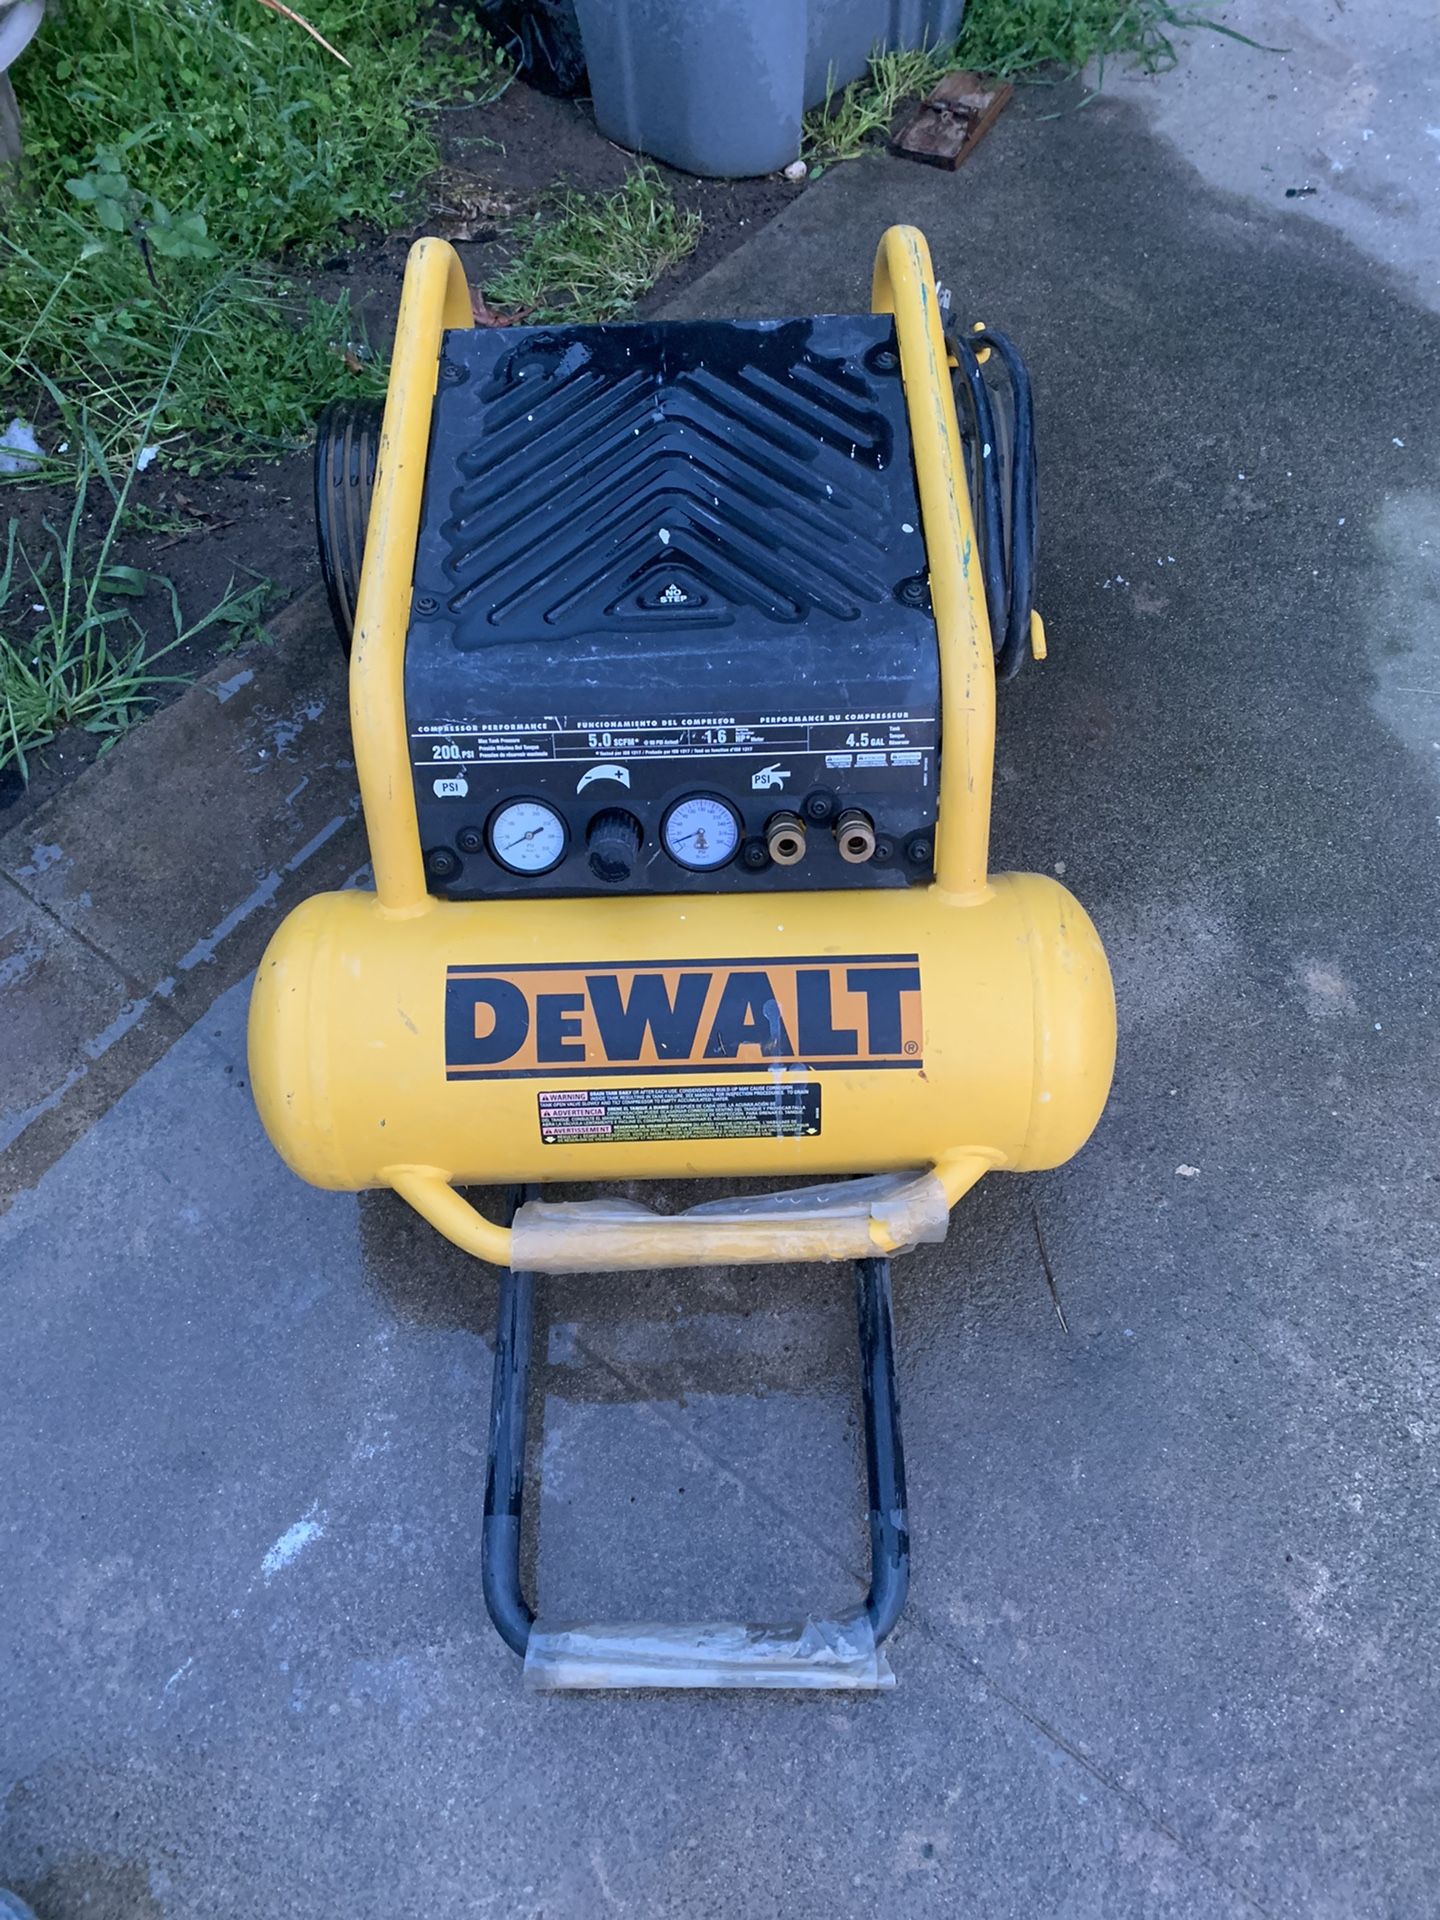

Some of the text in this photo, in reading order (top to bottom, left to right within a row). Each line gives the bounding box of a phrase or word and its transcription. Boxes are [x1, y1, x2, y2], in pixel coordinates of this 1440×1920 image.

[760, 715, 824, 723] PERFORMANCE
[845, 712, 909, 721] COMPRESSEUR
[482, 723, 548, 731] PERFORMANCE
[577, 720, 658, 728] FUNCIONAMIENTO
[588, 733, 611, 747] 5.0
[705, 730, 727, 743] 1.6
[846, 732, 885, 747] 4.5 GAL
[432, 745, 460, 759] 200
[755, 775, 770, 784] PSI
[442, 783, 458, 792] PSI
[445, 967, 920, 1065] DEWALT
